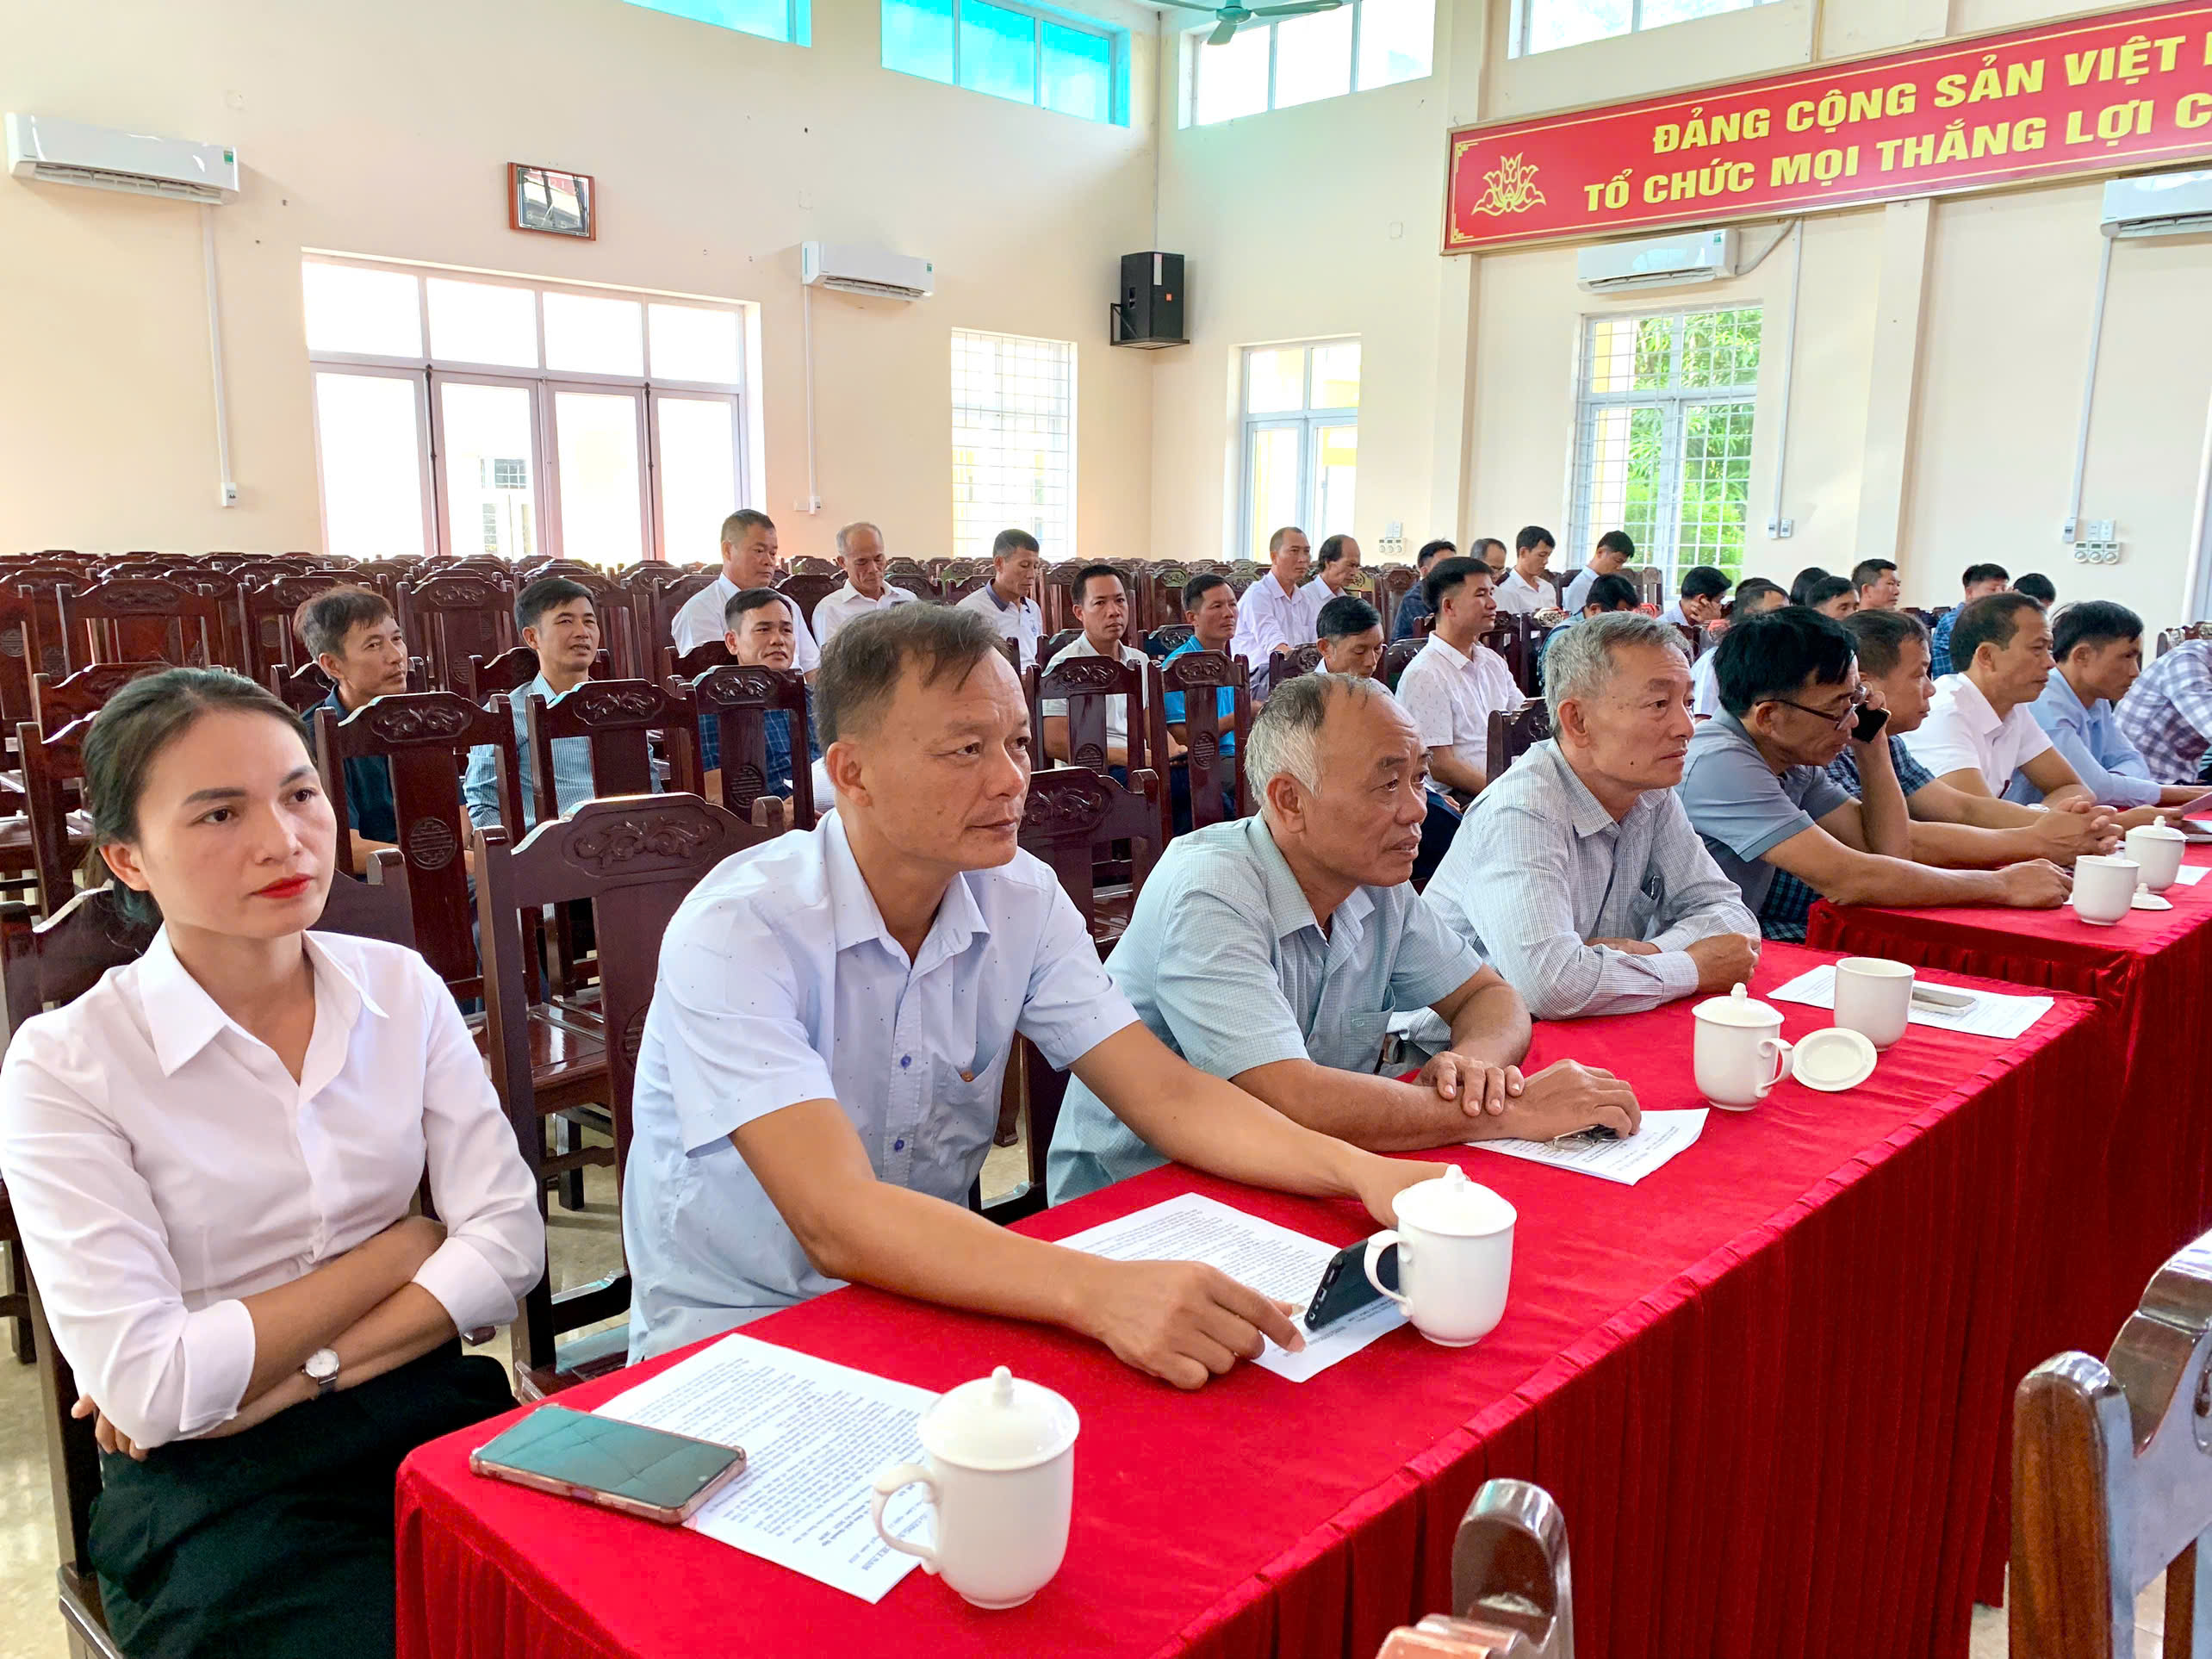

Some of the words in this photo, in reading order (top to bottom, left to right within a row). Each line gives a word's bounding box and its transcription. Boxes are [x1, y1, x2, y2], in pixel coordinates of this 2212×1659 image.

[1652, 106, 1771, 154] ĐẢNG
[1786, 83, 1917, 134] CỘNG
[1934, 53, 2045, 108] SẢN
[2064, 34, 2186, 86] VIỆT
[1584, 169, 1633, 212] TỔ
[1643, 158, 1755, 203] CHỨC
[1770, 145, 1860, 189] MỌI
[1875, 116, 2047, 172] THẮNG
[2065, 99, 2154, 147] LỢI
